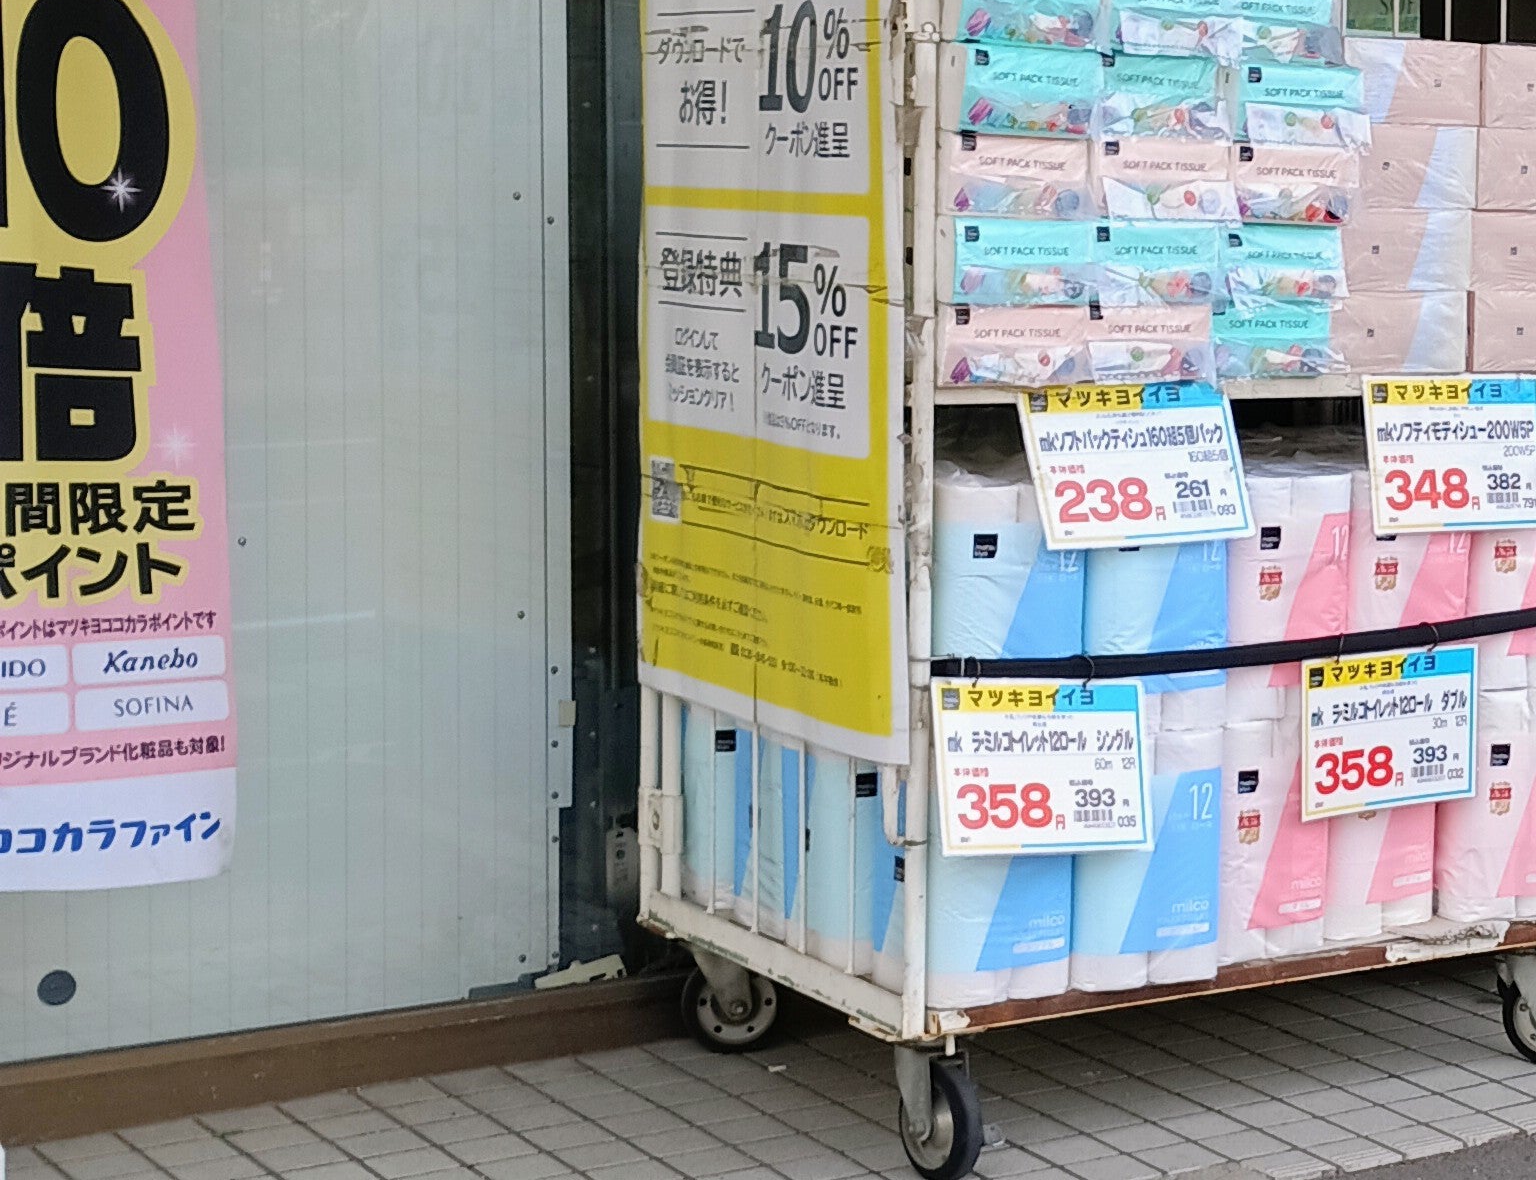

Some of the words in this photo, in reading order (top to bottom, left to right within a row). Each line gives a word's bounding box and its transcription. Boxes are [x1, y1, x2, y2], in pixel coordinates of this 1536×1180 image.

[678, 79, 728, 125] お得!
[818, 67, 859, 102] OFF
[765, 121, 850, 159] クーポン進呈
[979, 156, 1003, 167] SOFT
[1007, 158, 1031, 168] PACK
[1033, 159, 1066, 171] TISSUE
[1123, 160, 1148, 170] SOFT
[1151, 161, 1173, 171] PACK
[1175, 162, 1207, 172] TISSUE
[1256, 167, 1280, 177] SOFT
[1284, 168, 1305, 178] PACK
[1307, 169, 1336, 179] TISSUE
[984, 246, 1008, 256] SOFT
[1011, 246, 1035, 256] PACK
[1037, 246, 1069, 256] TISSUE
[1114, 246, 1138, 255] SOFT
[1141, 246, 1164, 255] PACK
[1167, 246, 1198, 256] TISSUE
[974, 328, 998, 338] SOFT
[1002, 328, 1025, 338] PACK
[1028, 328, 1061, 338] TISSUE
[1108, 324, 1133, 334] SOFT
[1136, 324, 1158, 333] PACK
[1161, 324, 1191, 334] TISSUE
[1229, 319, 1252, 329] SOFT
[813, 323, 859, 360] OFF
[1055, 386, 1181, 408] マツキヨイイヨ
[1394, 383, 1503, 400] マツキヨイイヨ
[1175, 479, 1211, 499] 261
[1384, 468, 1469, 511] 348
[1487, 473, 1521, 491] 382
[5, 480, 195, 537] 間限定
[1055, 477, 1151, 524] 238
[103, 647, 199, 674] Kanebo
[1331, 655, 1436, 682] マツキヨイイヨ
[113, 694, 194, 718] SOFINA
[967, 688, 1094, 707] マツキヨイイヨ
[1413, 745, 1447, 764] 393
[1315, 745, 1393, 795] 358
[957, 783, 1053, 830] 358
[1074, 788, 1116, 808] 393
[1189, 783, 1213, 821] 12
